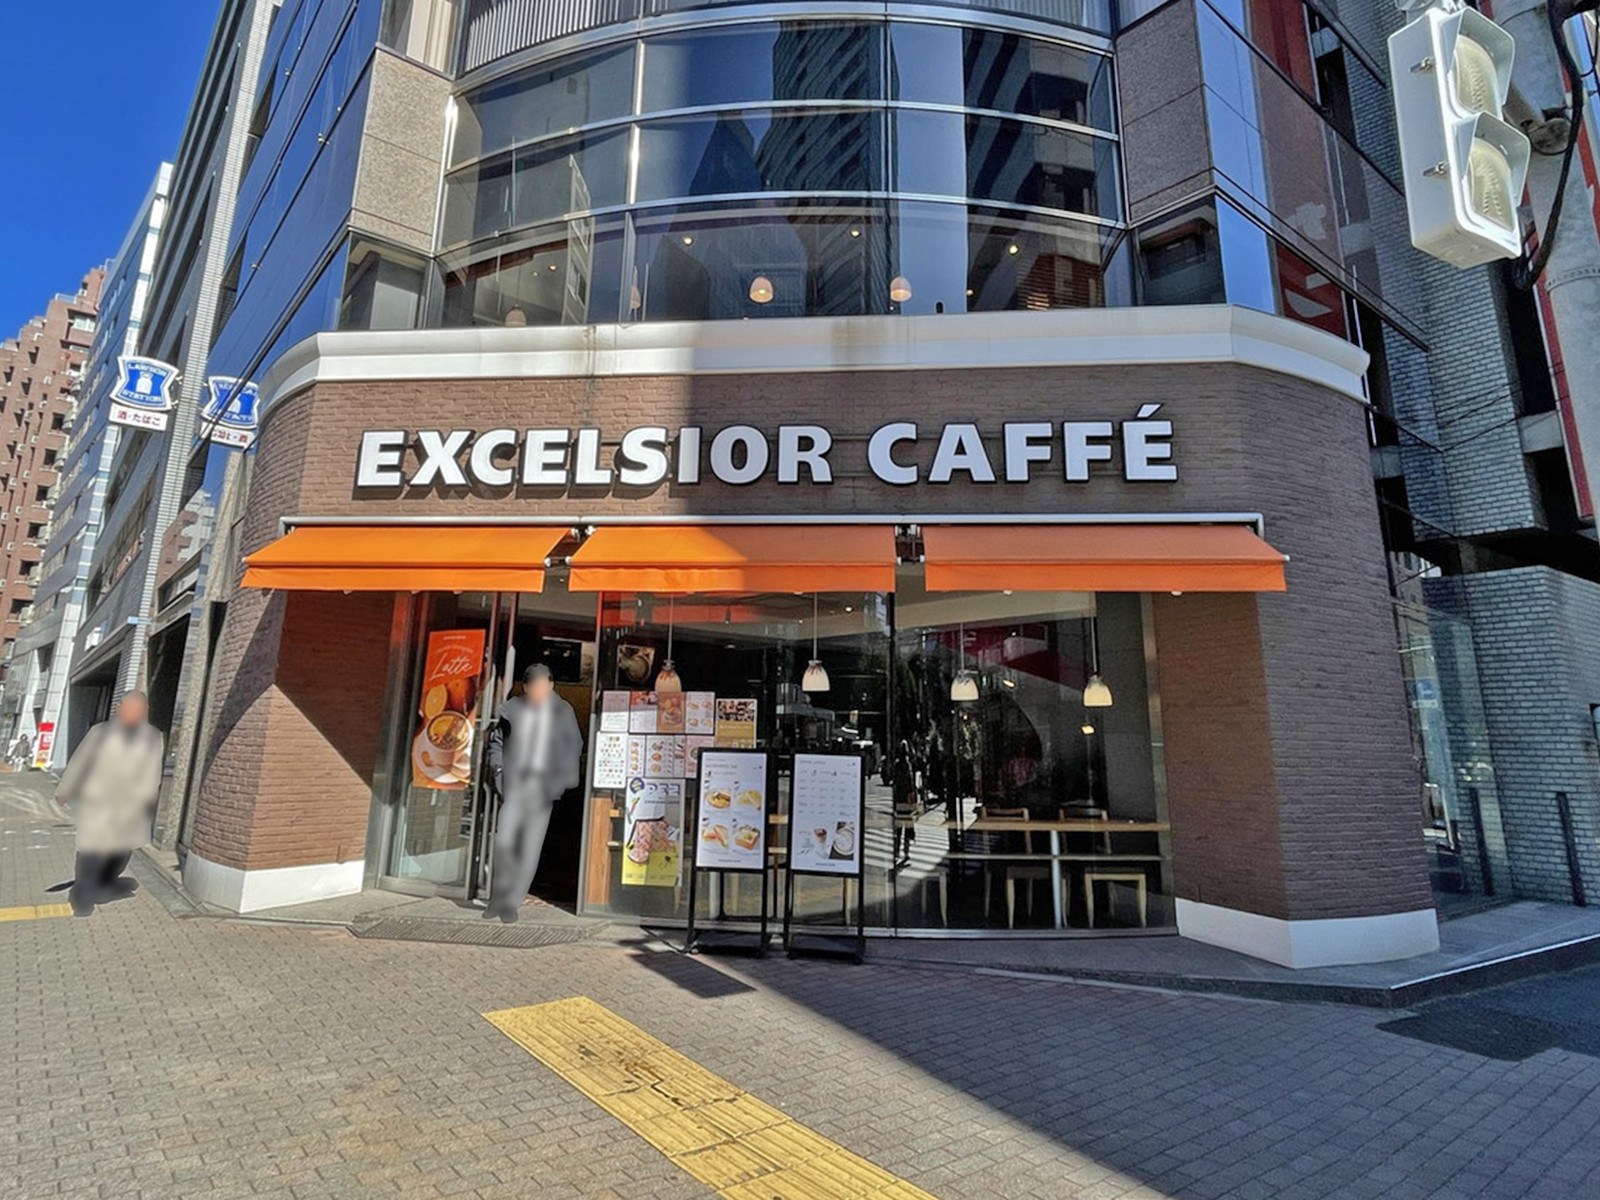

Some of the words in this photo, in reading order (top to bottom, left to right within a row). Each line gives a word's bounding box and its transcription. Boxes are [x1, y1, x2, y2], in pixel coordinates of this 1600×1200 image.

[121, 388, 163, 403] STATION
[355, 424, 834, 487] EXCELSIOR
[866, 403, 1178, 485] CAFFÉ
[428, 652, 474, 681] Latte
